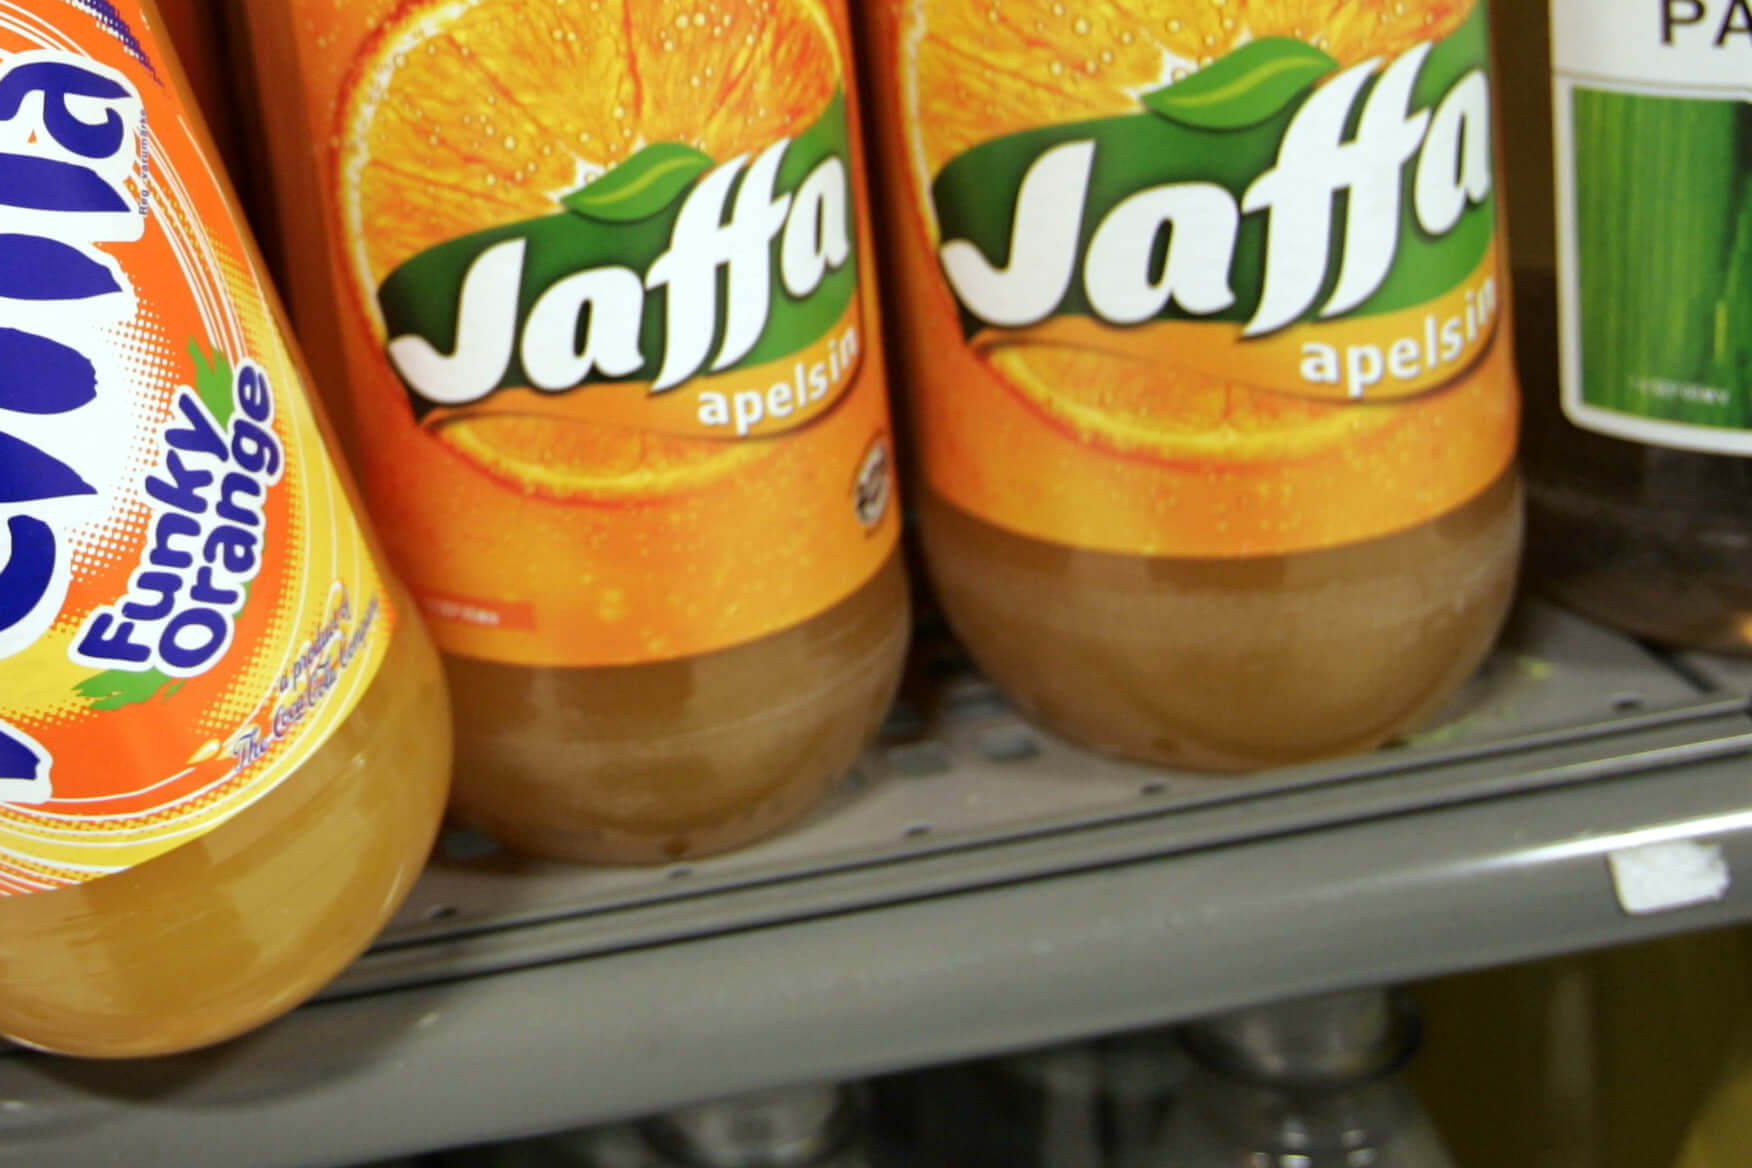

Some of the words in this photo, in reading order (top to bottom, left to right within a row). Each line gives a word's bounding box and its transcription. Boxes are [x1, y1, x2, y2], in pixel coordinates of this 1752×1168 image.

[388, 136, 850, 405] Jaffa
[940, 39, 1491, 339] Jaffa
[697, 326, 859, 438] apelsin
[1299, 276, 1496, 399] apelsin
[77, 392, 230, 663] Funky
[158, 364, 281, 669] Orange
[233, 726, 270, 772] The
